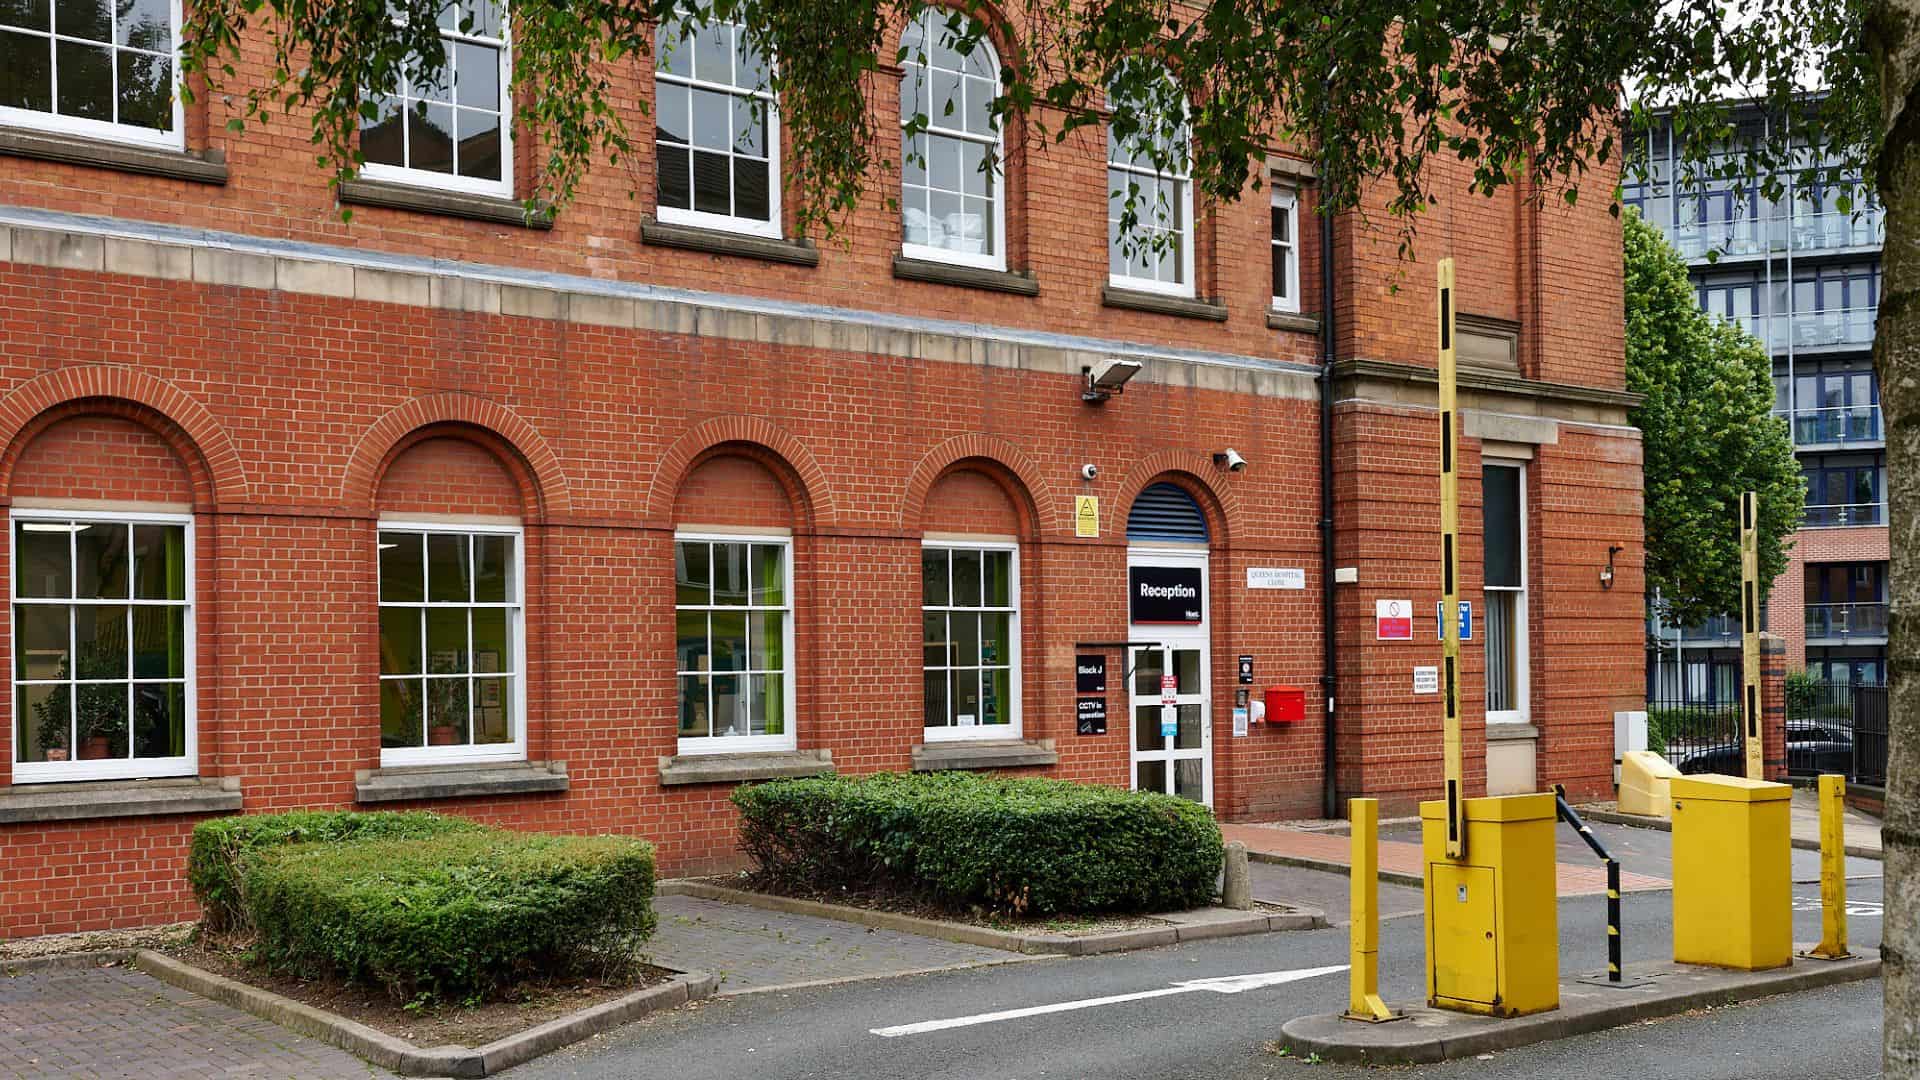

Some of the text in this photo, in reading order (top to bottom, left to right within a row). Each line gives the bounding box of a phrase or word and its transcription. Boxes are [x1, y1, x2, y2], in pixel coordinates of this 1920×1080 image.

[1140, 583, 1196, 600] Reception
[1078, 665, 1103, 674] Block J
[1079, 702, 1096, 710] CCTV
[1079, 712, 1105, 720] operation
